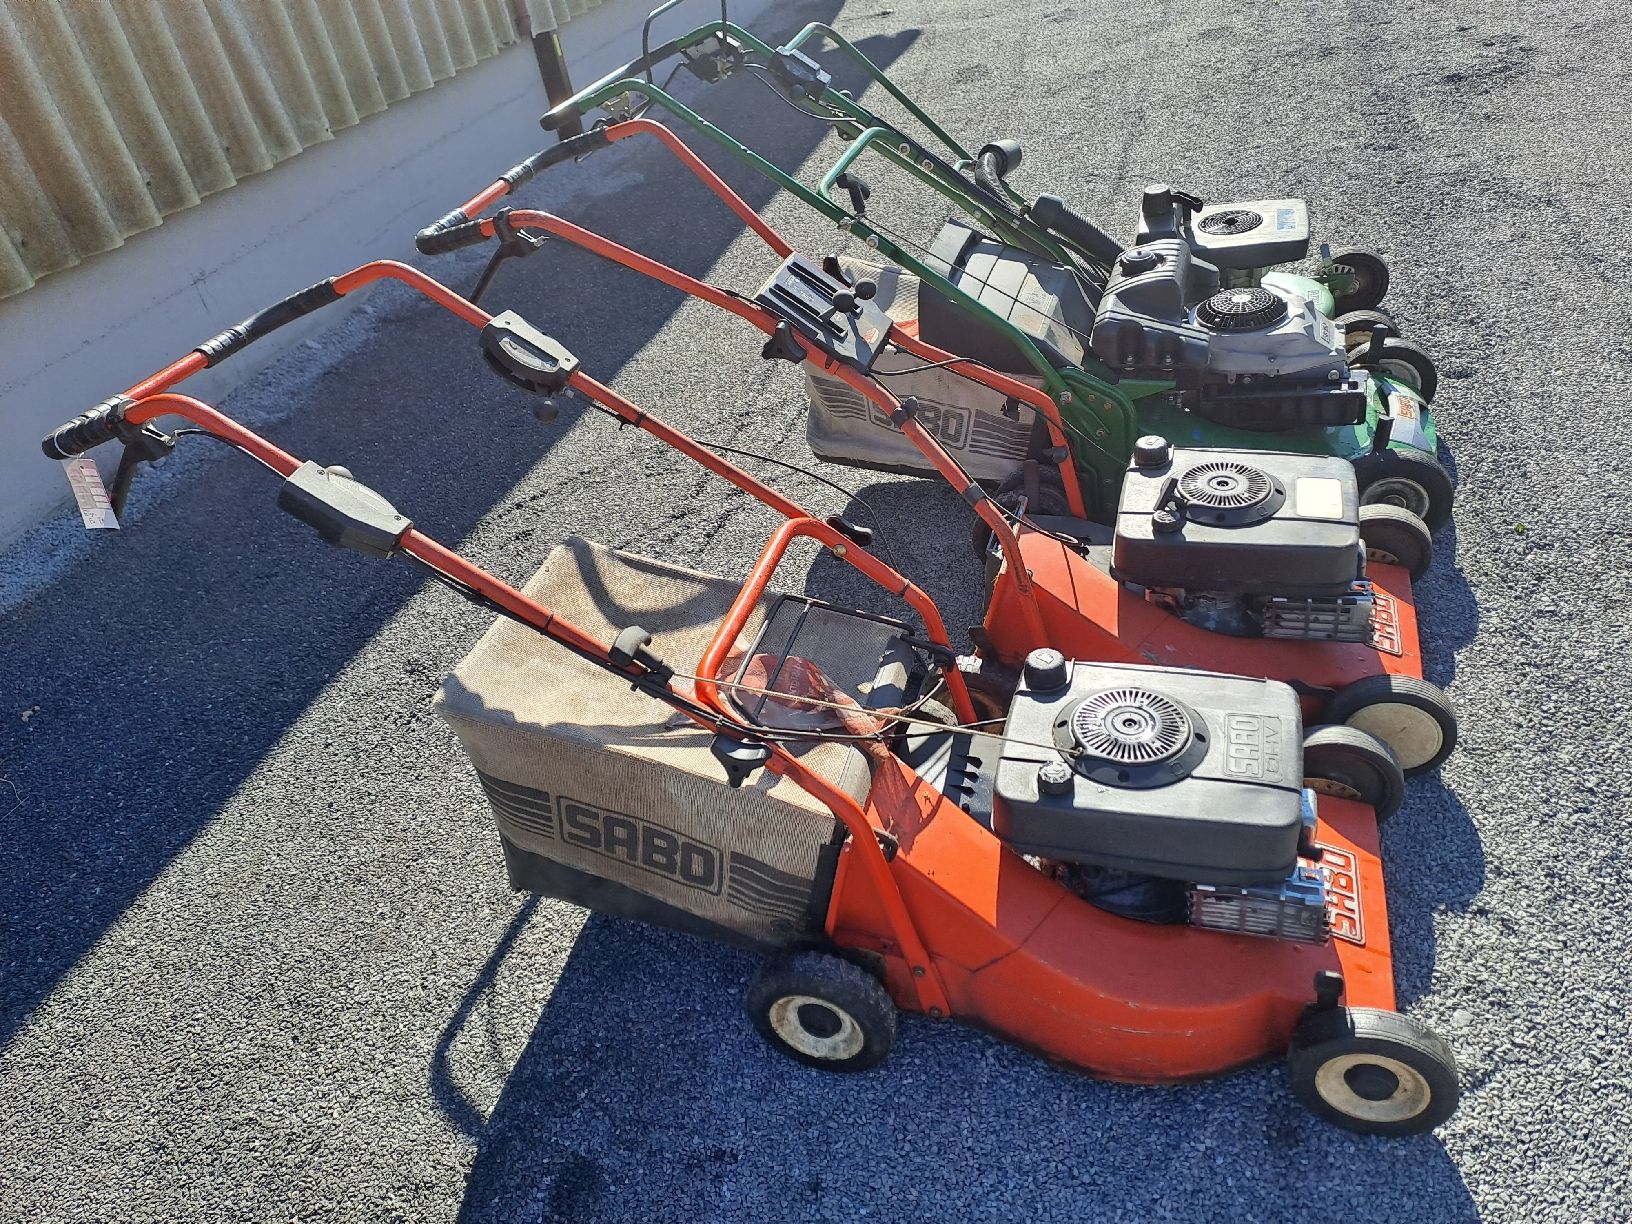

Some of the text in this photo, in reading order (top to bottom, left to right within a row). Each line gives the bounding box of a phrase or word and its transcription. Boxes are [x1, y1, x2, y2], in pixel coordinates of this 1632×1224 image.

[1228, 716, 1259, 775] SABO
[1265, 726, 1279, 773] OHV
[565, 804, 715, 887] SABO
